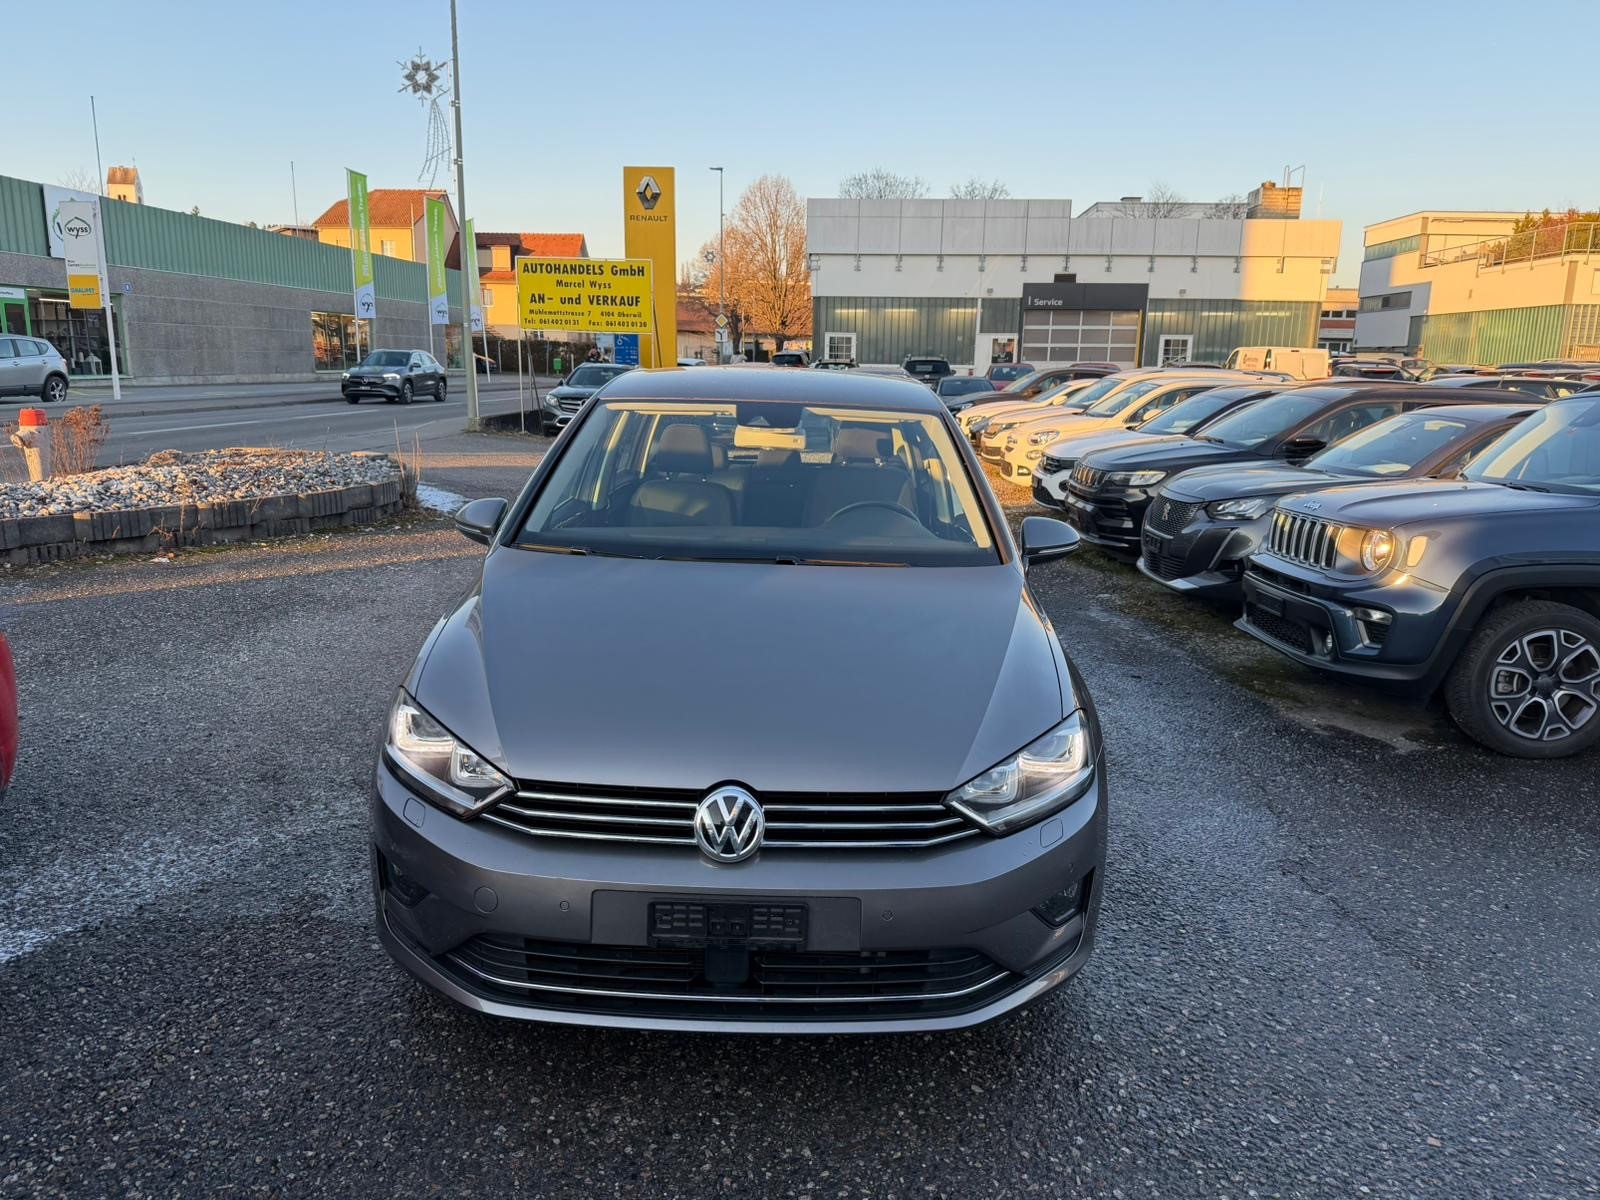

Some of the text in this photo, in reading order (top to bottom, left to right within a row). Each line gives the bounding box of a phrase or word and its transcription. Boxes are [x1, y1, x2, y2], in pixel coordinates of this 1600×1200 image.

[67, 226, 88, 239] wyss
[522, 263, 645, 277] AUTOHANDELS GmbH
[556, 280, 612, 290] Marcel Wyss
[560, 294, 581, 305] und
[588, 295, 641, 307] VERKAUF
[1034, 298, 1063, 306] Service
